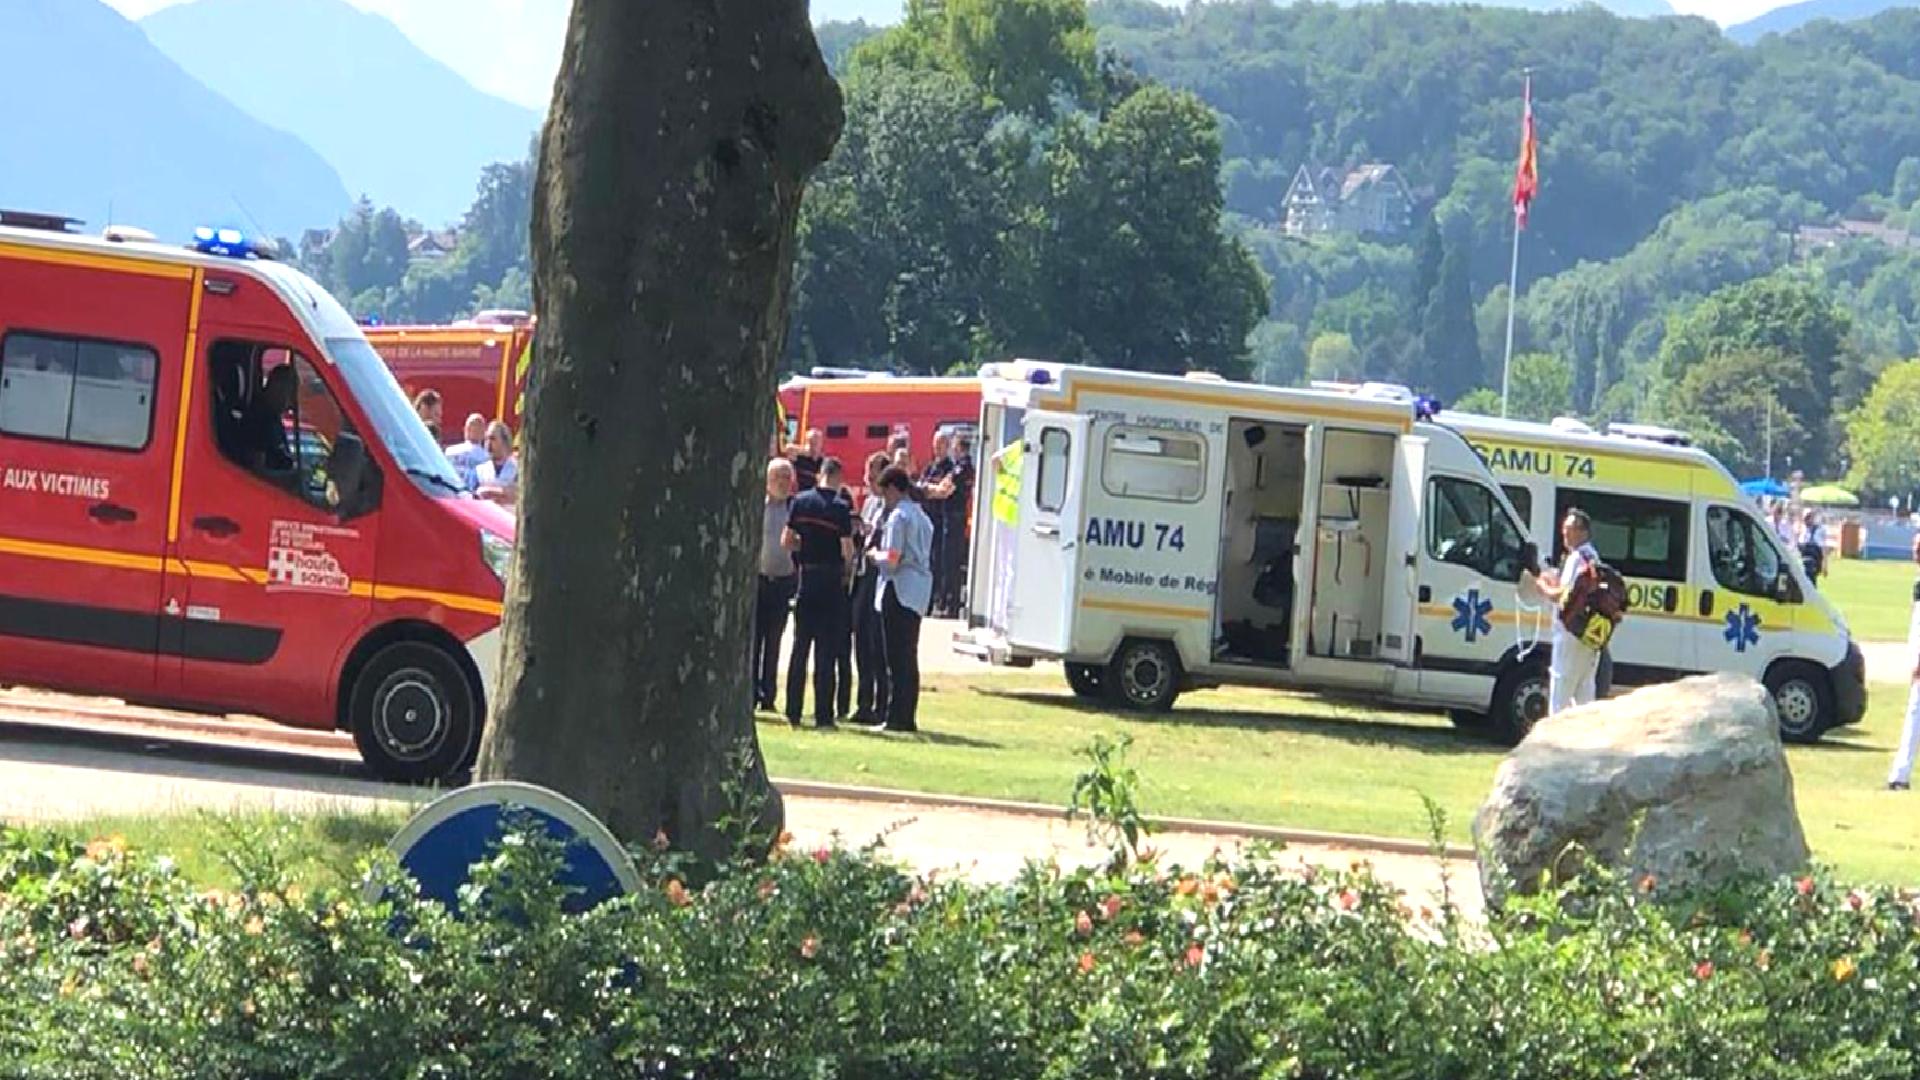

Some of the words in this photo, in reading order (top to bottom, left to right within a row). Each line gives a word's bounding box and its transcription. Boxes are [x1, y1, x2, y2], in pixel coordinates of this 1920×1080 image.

[1563, 455, 1595, 479] 74
[3, 468, 37, 491] AUX
[40, 472, 110, 500] VICTIMES
[1085, 517, 1145, 548] AMU
[1155, 523, 1185, 552] 74
[296, 554, 336, 572] haute
[301, 571, 346, 587] savoie
[1100, 568, 1154, 586] Mobile
[1159, 574, 1180, 588] de
[1628, 583, 1664, 611] OIS
